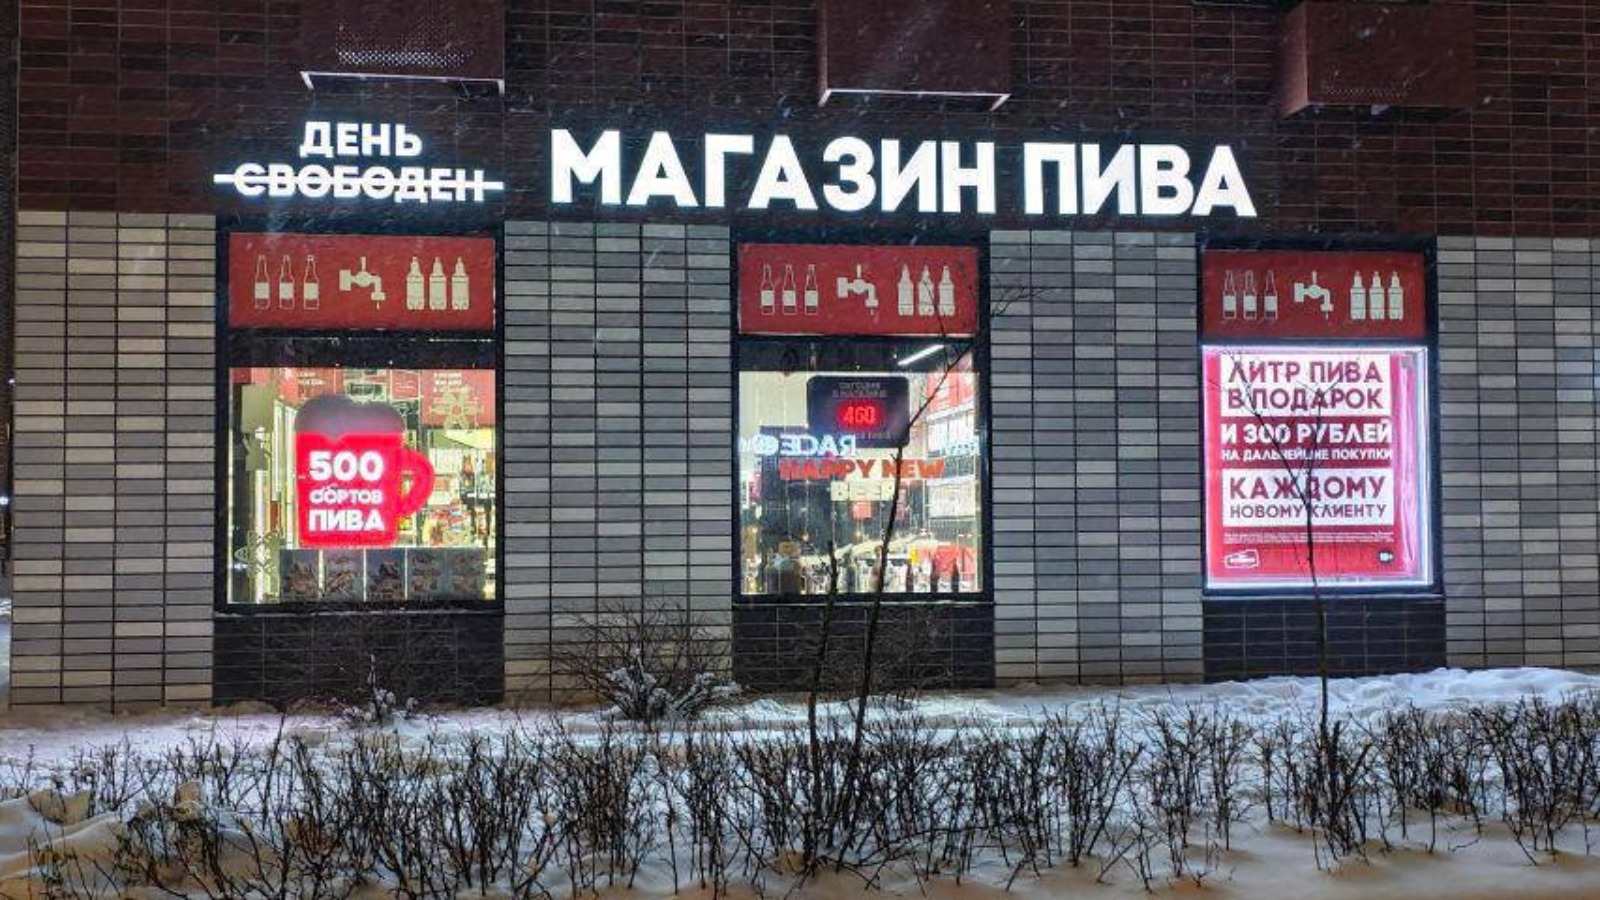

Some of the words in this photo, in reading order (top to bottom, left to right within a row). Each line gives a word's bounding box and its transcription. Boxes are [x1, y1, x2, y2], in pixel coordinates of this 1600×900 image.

[300, 121, 423, 158] ДЕНЬ
[232, 162, 485, 204] СВОБОДЕН
[550, 128, 996, 214] МАГАЗИН
[1023, 142, 1257, 218] ПИВА
[1228, 361, 1301, 383] ЛИТР
[1310, 361, 1383, 383] ПИВА
[1228, 388, 1244, 409] В
[1252, 388, 1384, 411] ПОДАРОК
[1220, 423, 1237, 444] И
[1243, 423, 1291, 444] 300
[1297, 419, 1393, 444] РУБЛЕЙ
[308, 450, 385, 482] 500
[1221, 449, 1241, 461] НА
[1331, 448, 1393, 461] ПОКУПКИ
[779, 459, 877, 480] HAPPY
[881, 459, 946, 479] NEW
[309, 488, 383, 505] СОРТОВ
[1230, 476, 1387, 501] КАЖДОМУ
[308, 509, 386, 532] ПИВА
[1230, 504, 1303, 518] НОВОМУ
[1310, 504, 1387, 518] КЛИЕНТУ
